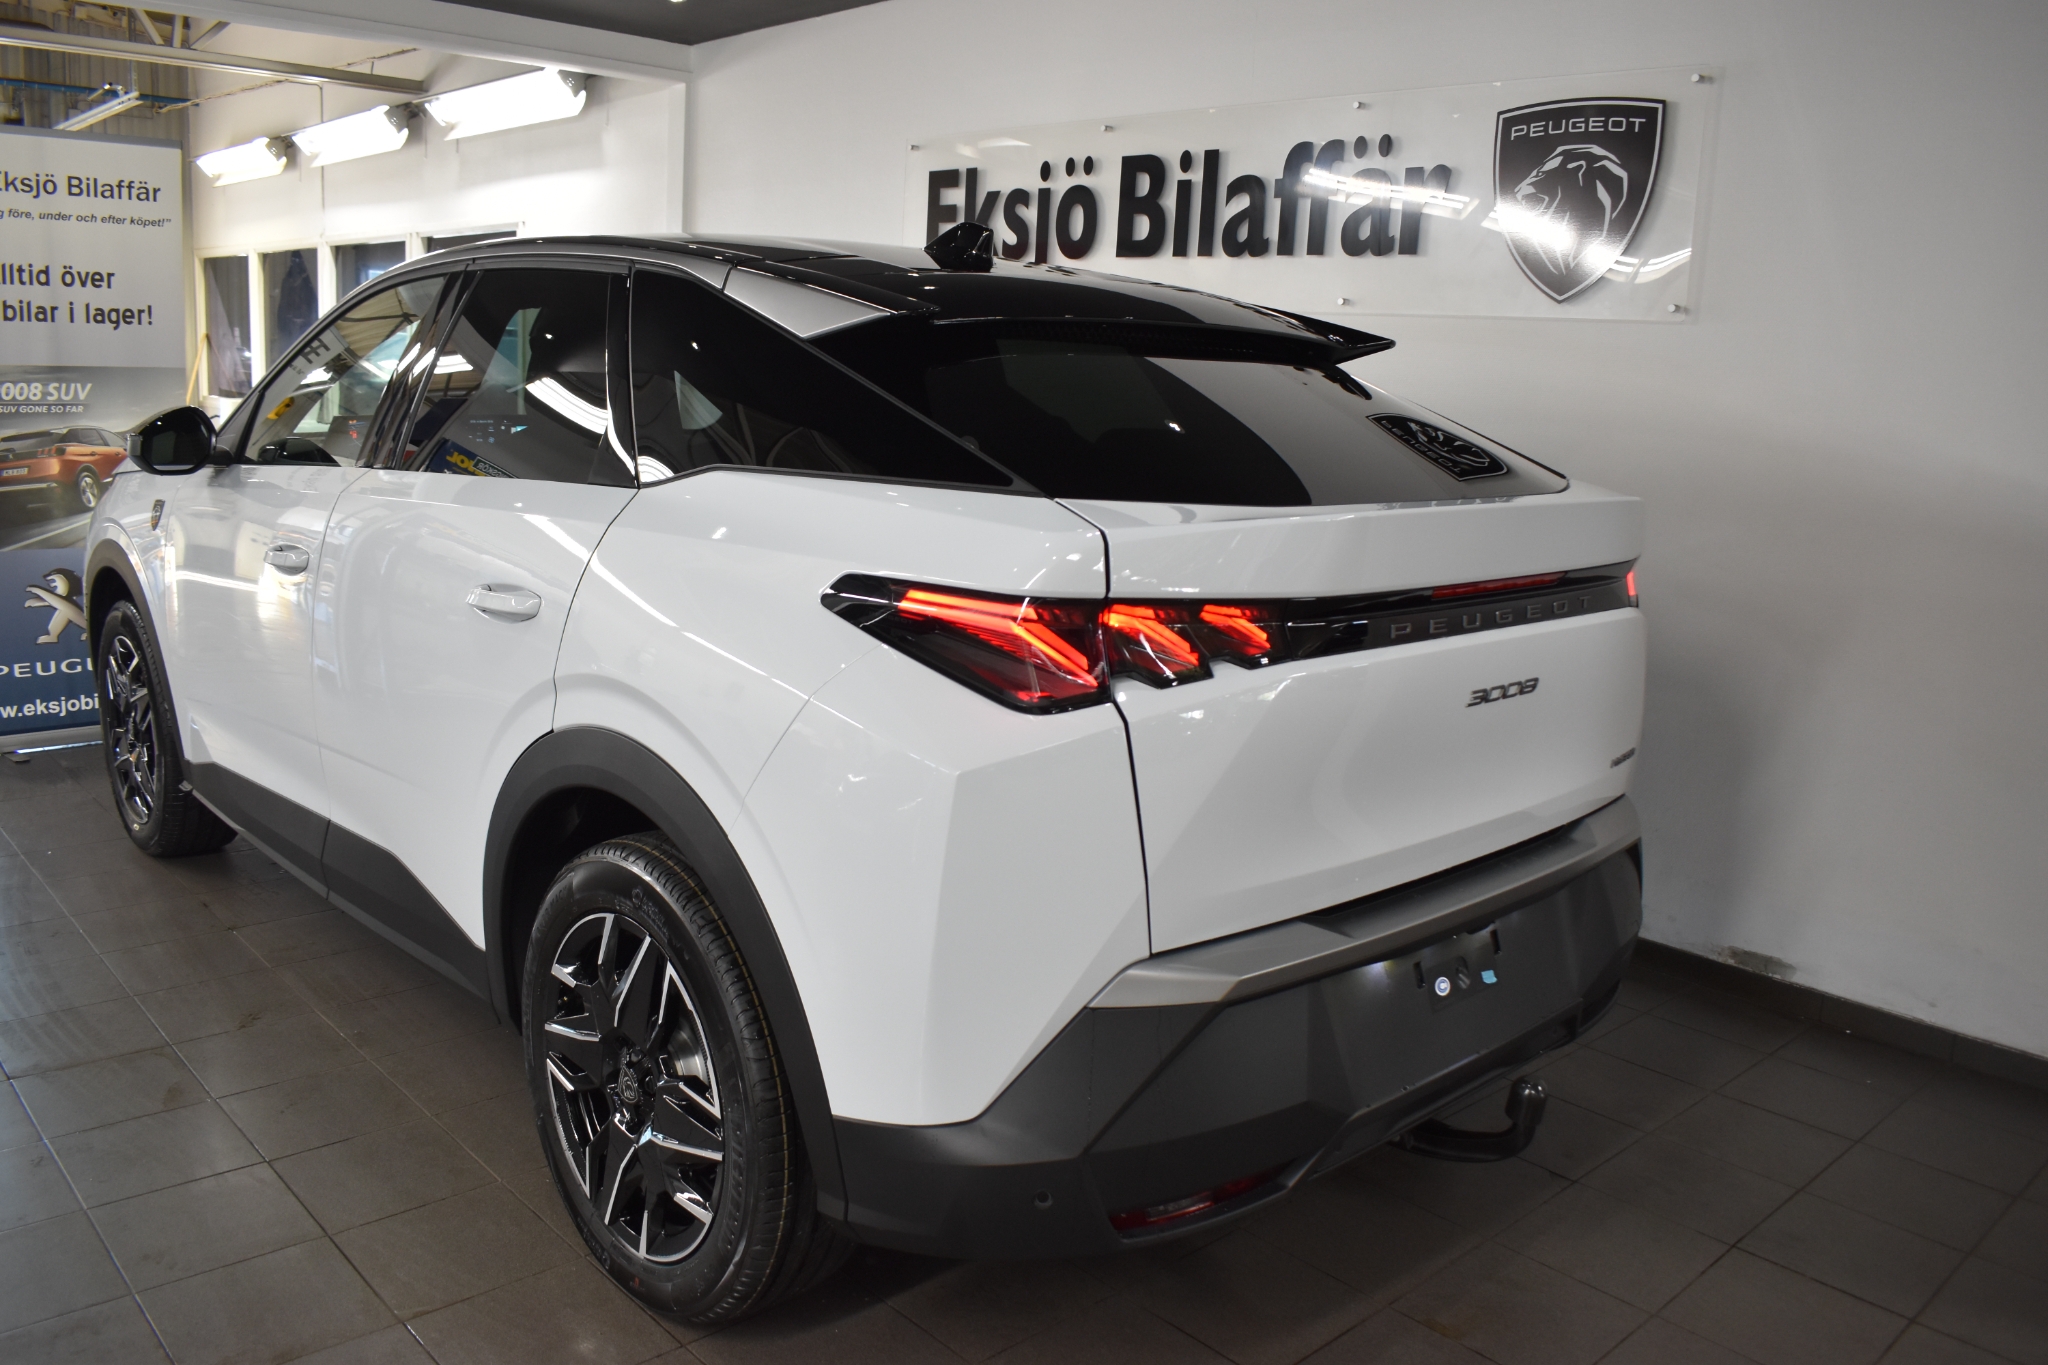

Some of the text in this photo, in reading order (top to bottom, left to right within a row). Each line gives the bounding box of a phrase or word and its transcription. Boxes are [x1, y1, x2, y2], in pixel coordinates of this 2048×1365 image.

[1511, 117, 1646, 141] PEUGEOT
[0, 171, 161, 202] ksjö Bilaffär
[926, 133, 1452, 264] Eksjö Bilaffär
[8, 209, 35, 221] före,
[39, 211, 73, 222] under
[76, 213, 97, 223] och
[101, 215, 127, 225] efter
[0, 263, 115, 289] lltid över
[3, 300, 153, 331] bilar i lager!
[0, 382, 92, 401] 008 SUV
[19, 405, 48, 413] GONE
[50, 405, 63, 413] SO
[1390, 596, 1591, 639] PEUGEOT
[1465, 677, 1539, 708] 3008
